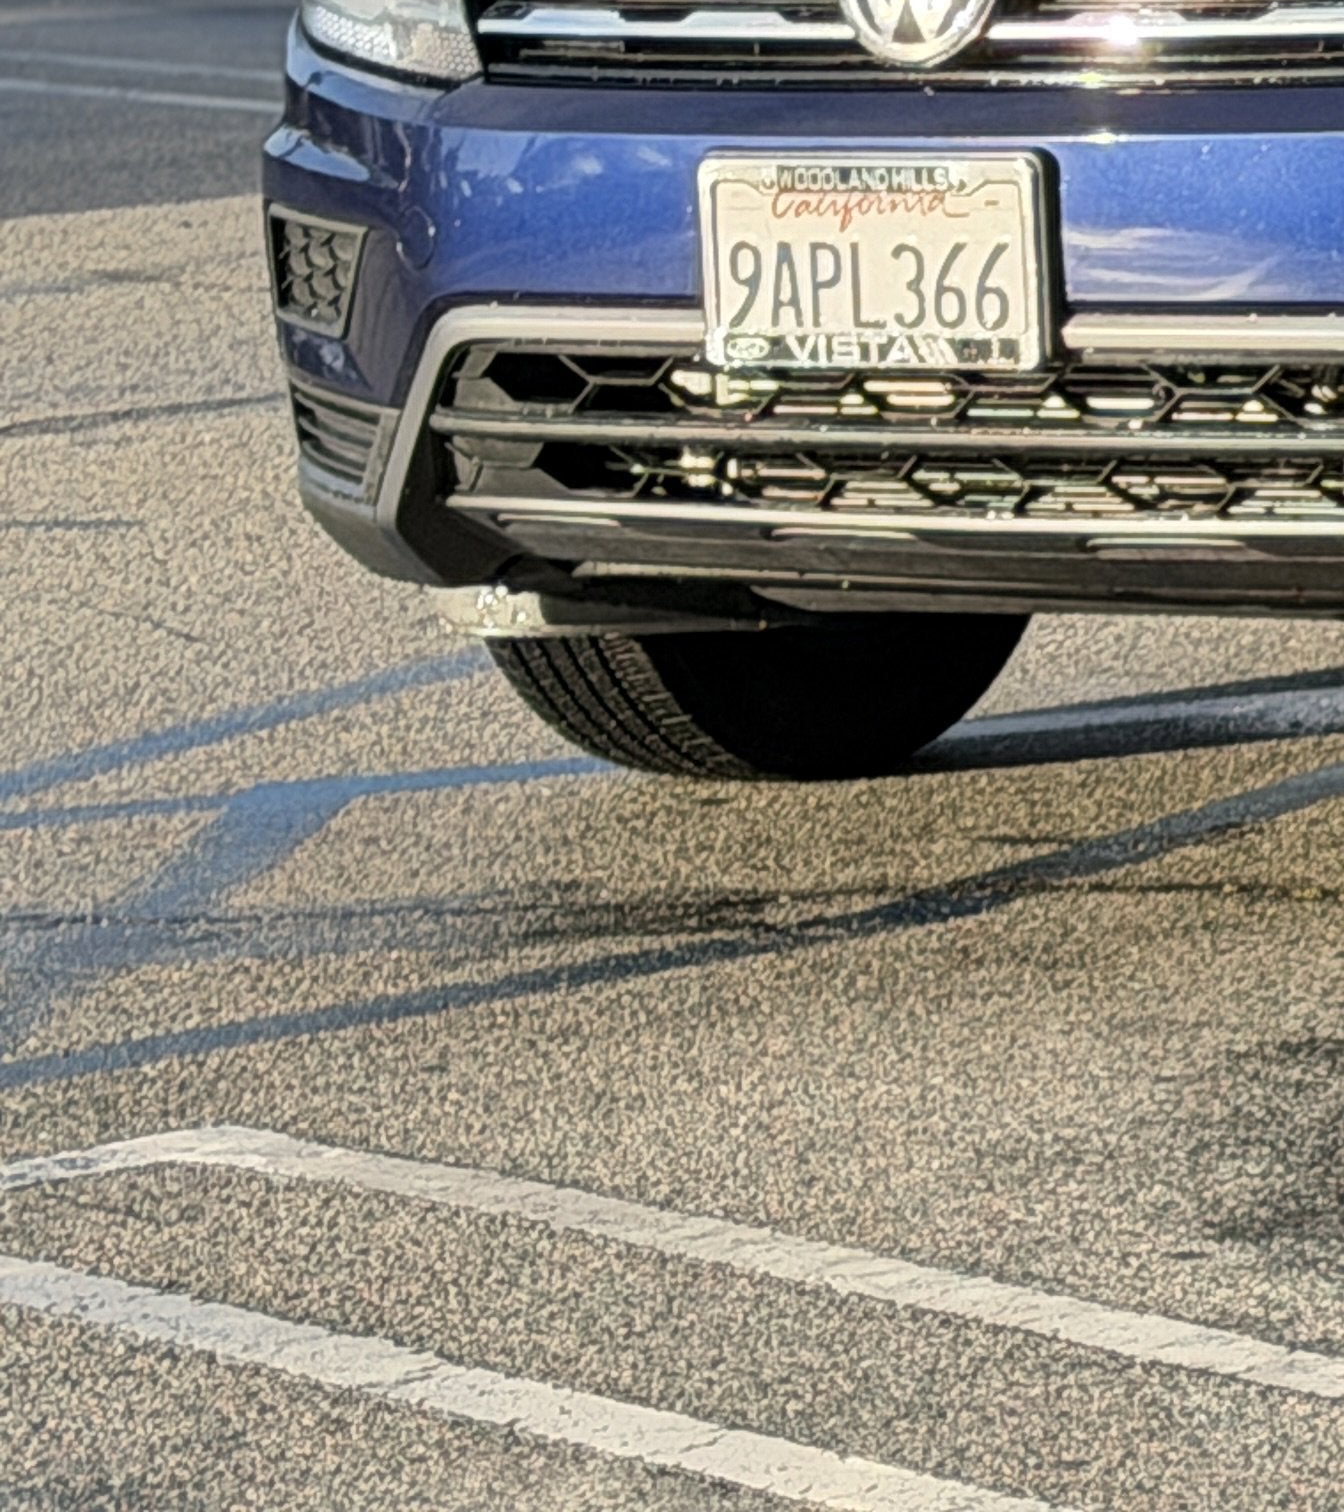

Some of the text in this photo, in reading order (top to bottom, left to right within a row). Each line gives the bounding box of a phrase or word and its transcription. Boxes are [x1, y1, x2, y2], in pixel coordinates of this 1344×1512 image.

[777, 166, 949, 190] WOODLAND HILLS
[771, 189, 970, 232] California
[728, 240, 1010, 330] 9APL366
[785, 334, 915, 364] VISTA
